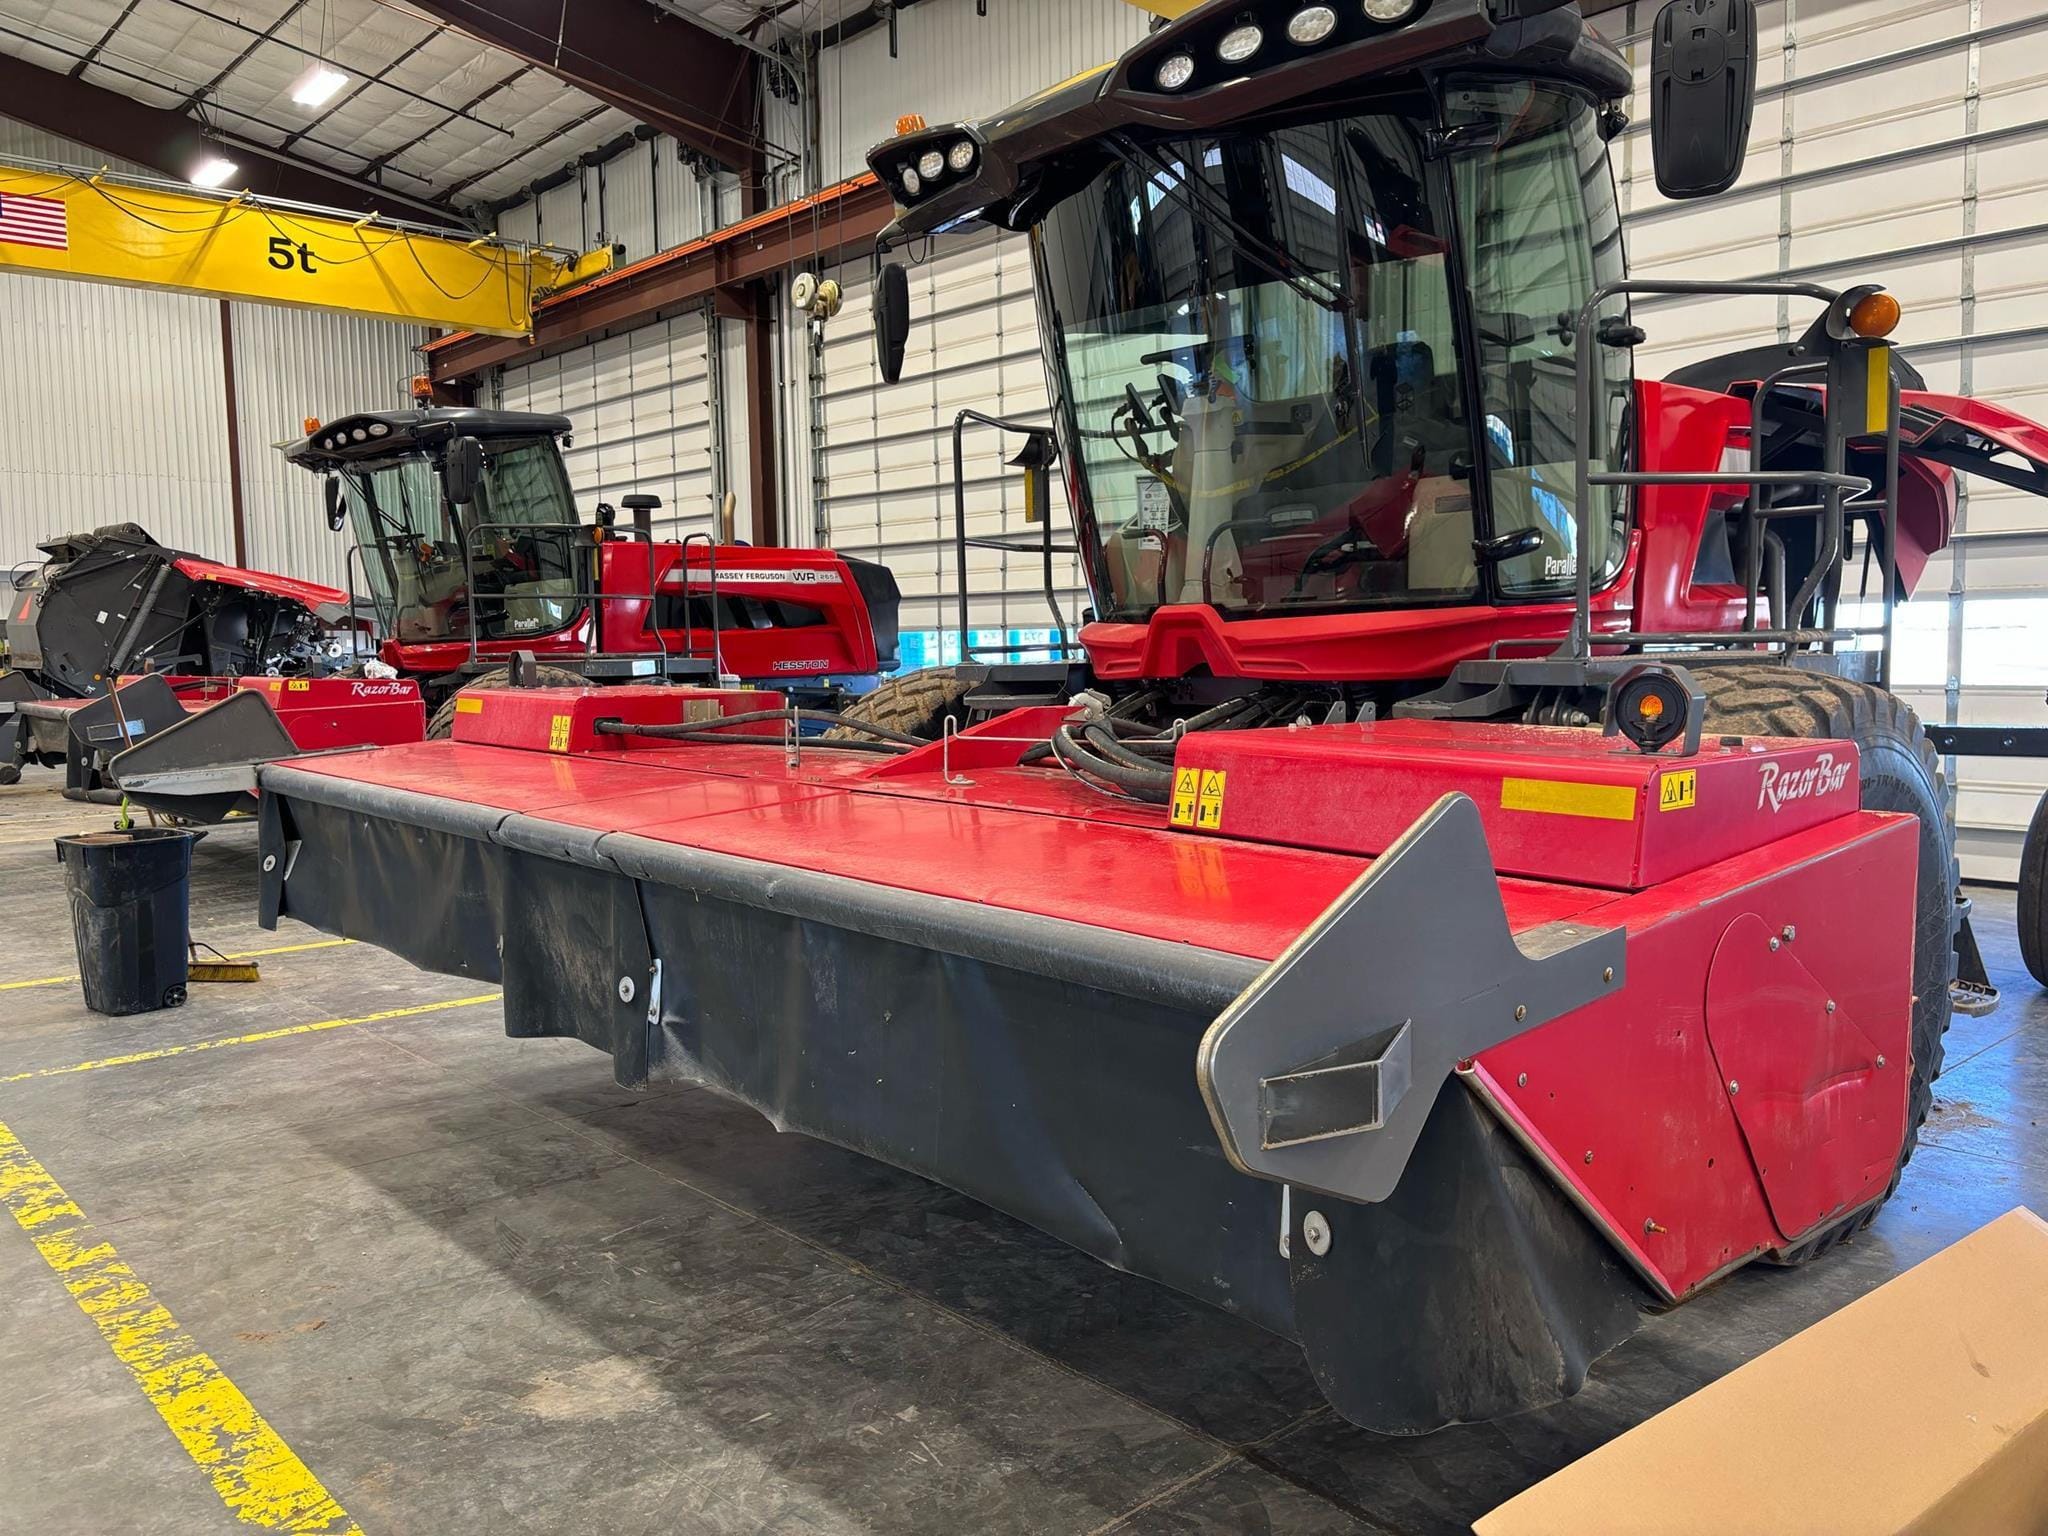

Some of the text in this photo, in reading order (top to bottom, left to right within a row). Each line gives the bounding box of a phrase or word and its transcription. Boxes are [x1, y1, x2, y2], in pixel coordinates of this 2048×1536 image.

[268, 236, 317, 274] 5t
[1545, 553, 1577, 576] Paralle
[746, 572, 786, 580] FERGUSON
[792, 572, 816, 582] WR
[772, 659, 829, 670] HESSTON
[351, 682, 413, 697] RazorBar
[1757, 753, 1852, 814] RazorBar
